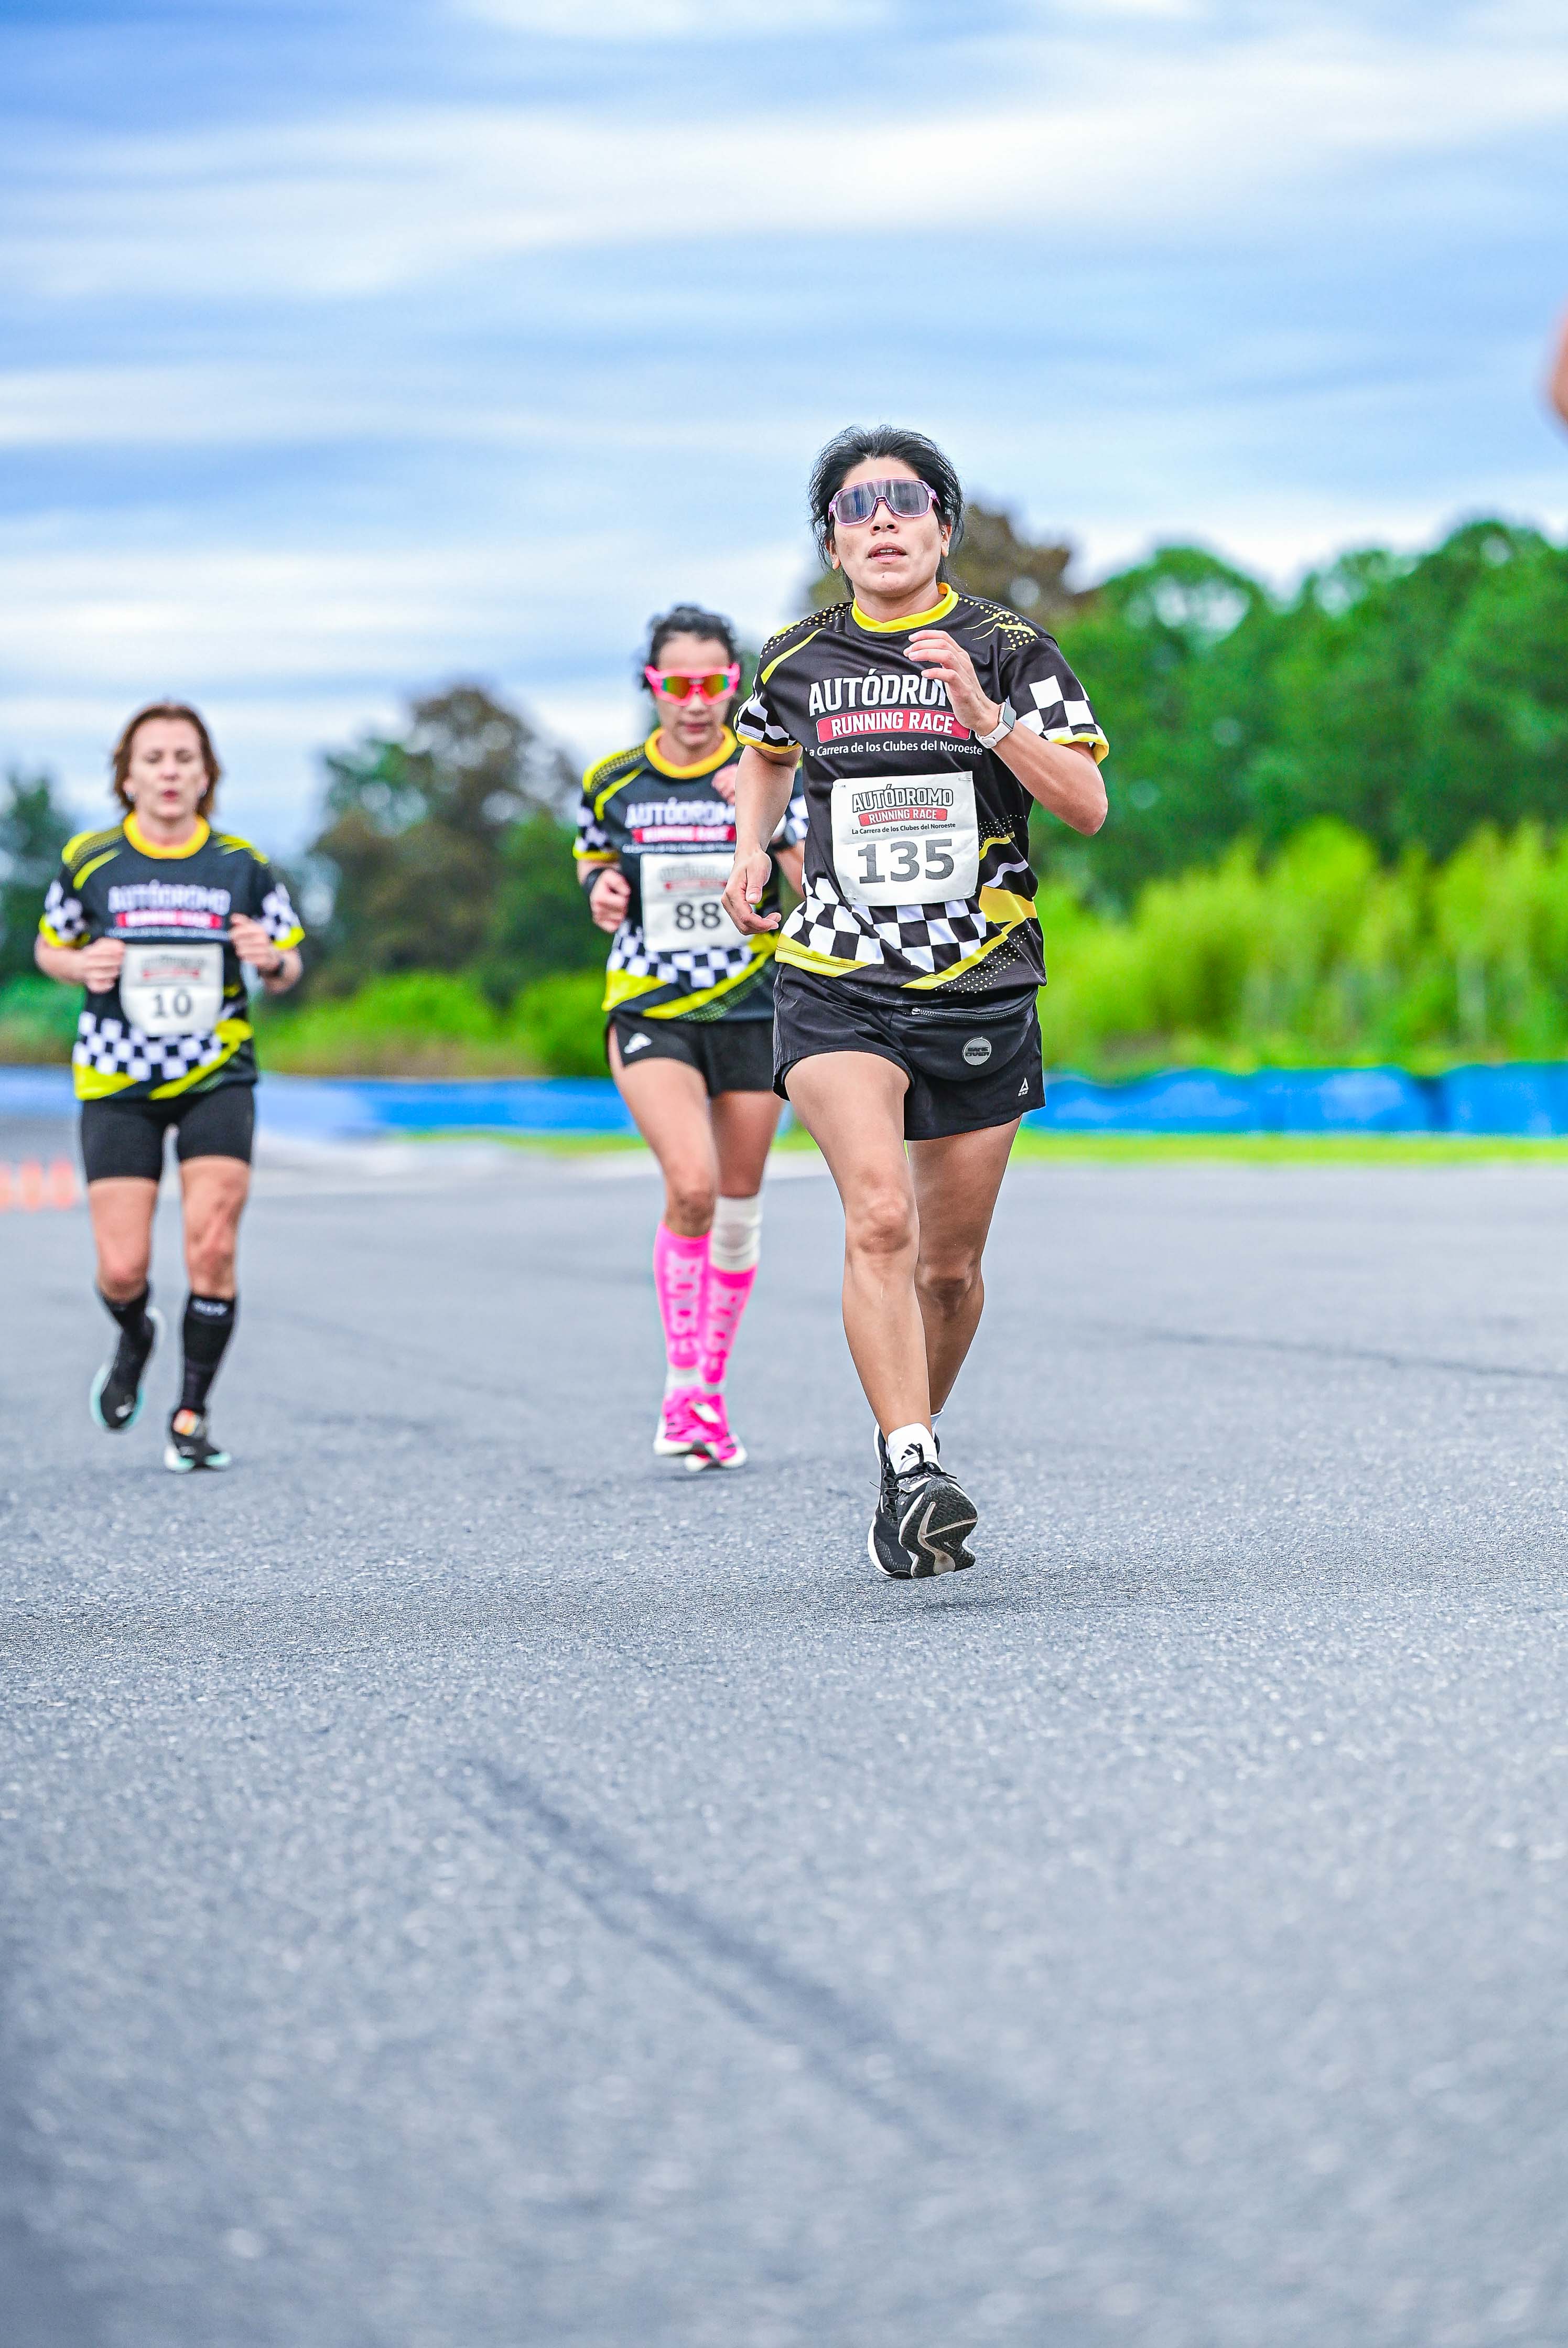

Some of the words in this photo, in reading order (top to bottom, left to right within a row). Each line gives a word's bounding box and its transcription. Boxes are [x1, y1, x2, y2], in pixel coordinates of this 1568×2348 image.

[809, 669, 946, 717] AUTÓDRO
[831, 712, 904, 737] RUNNING
[909, 712, 954, 735] RACE
[817, 746, 849, 756] Carrera
[850, 742, 864, 753] de
[866, 741, 881, 752] los
[885, 740, 918, 752] Clubes
[921, 740, 937, 751] del
[939, 740, 983, 755] Noroeste
[852, 784, 954, 813] AUTÓDROMO
[868, 809, 910, 824] RUNNING
[913, 809, 937, 820] RACE
[858, 838, 954, 884] 135
[676, 902, 721, 931] 88
[152, 989, 192, 1017] 10
